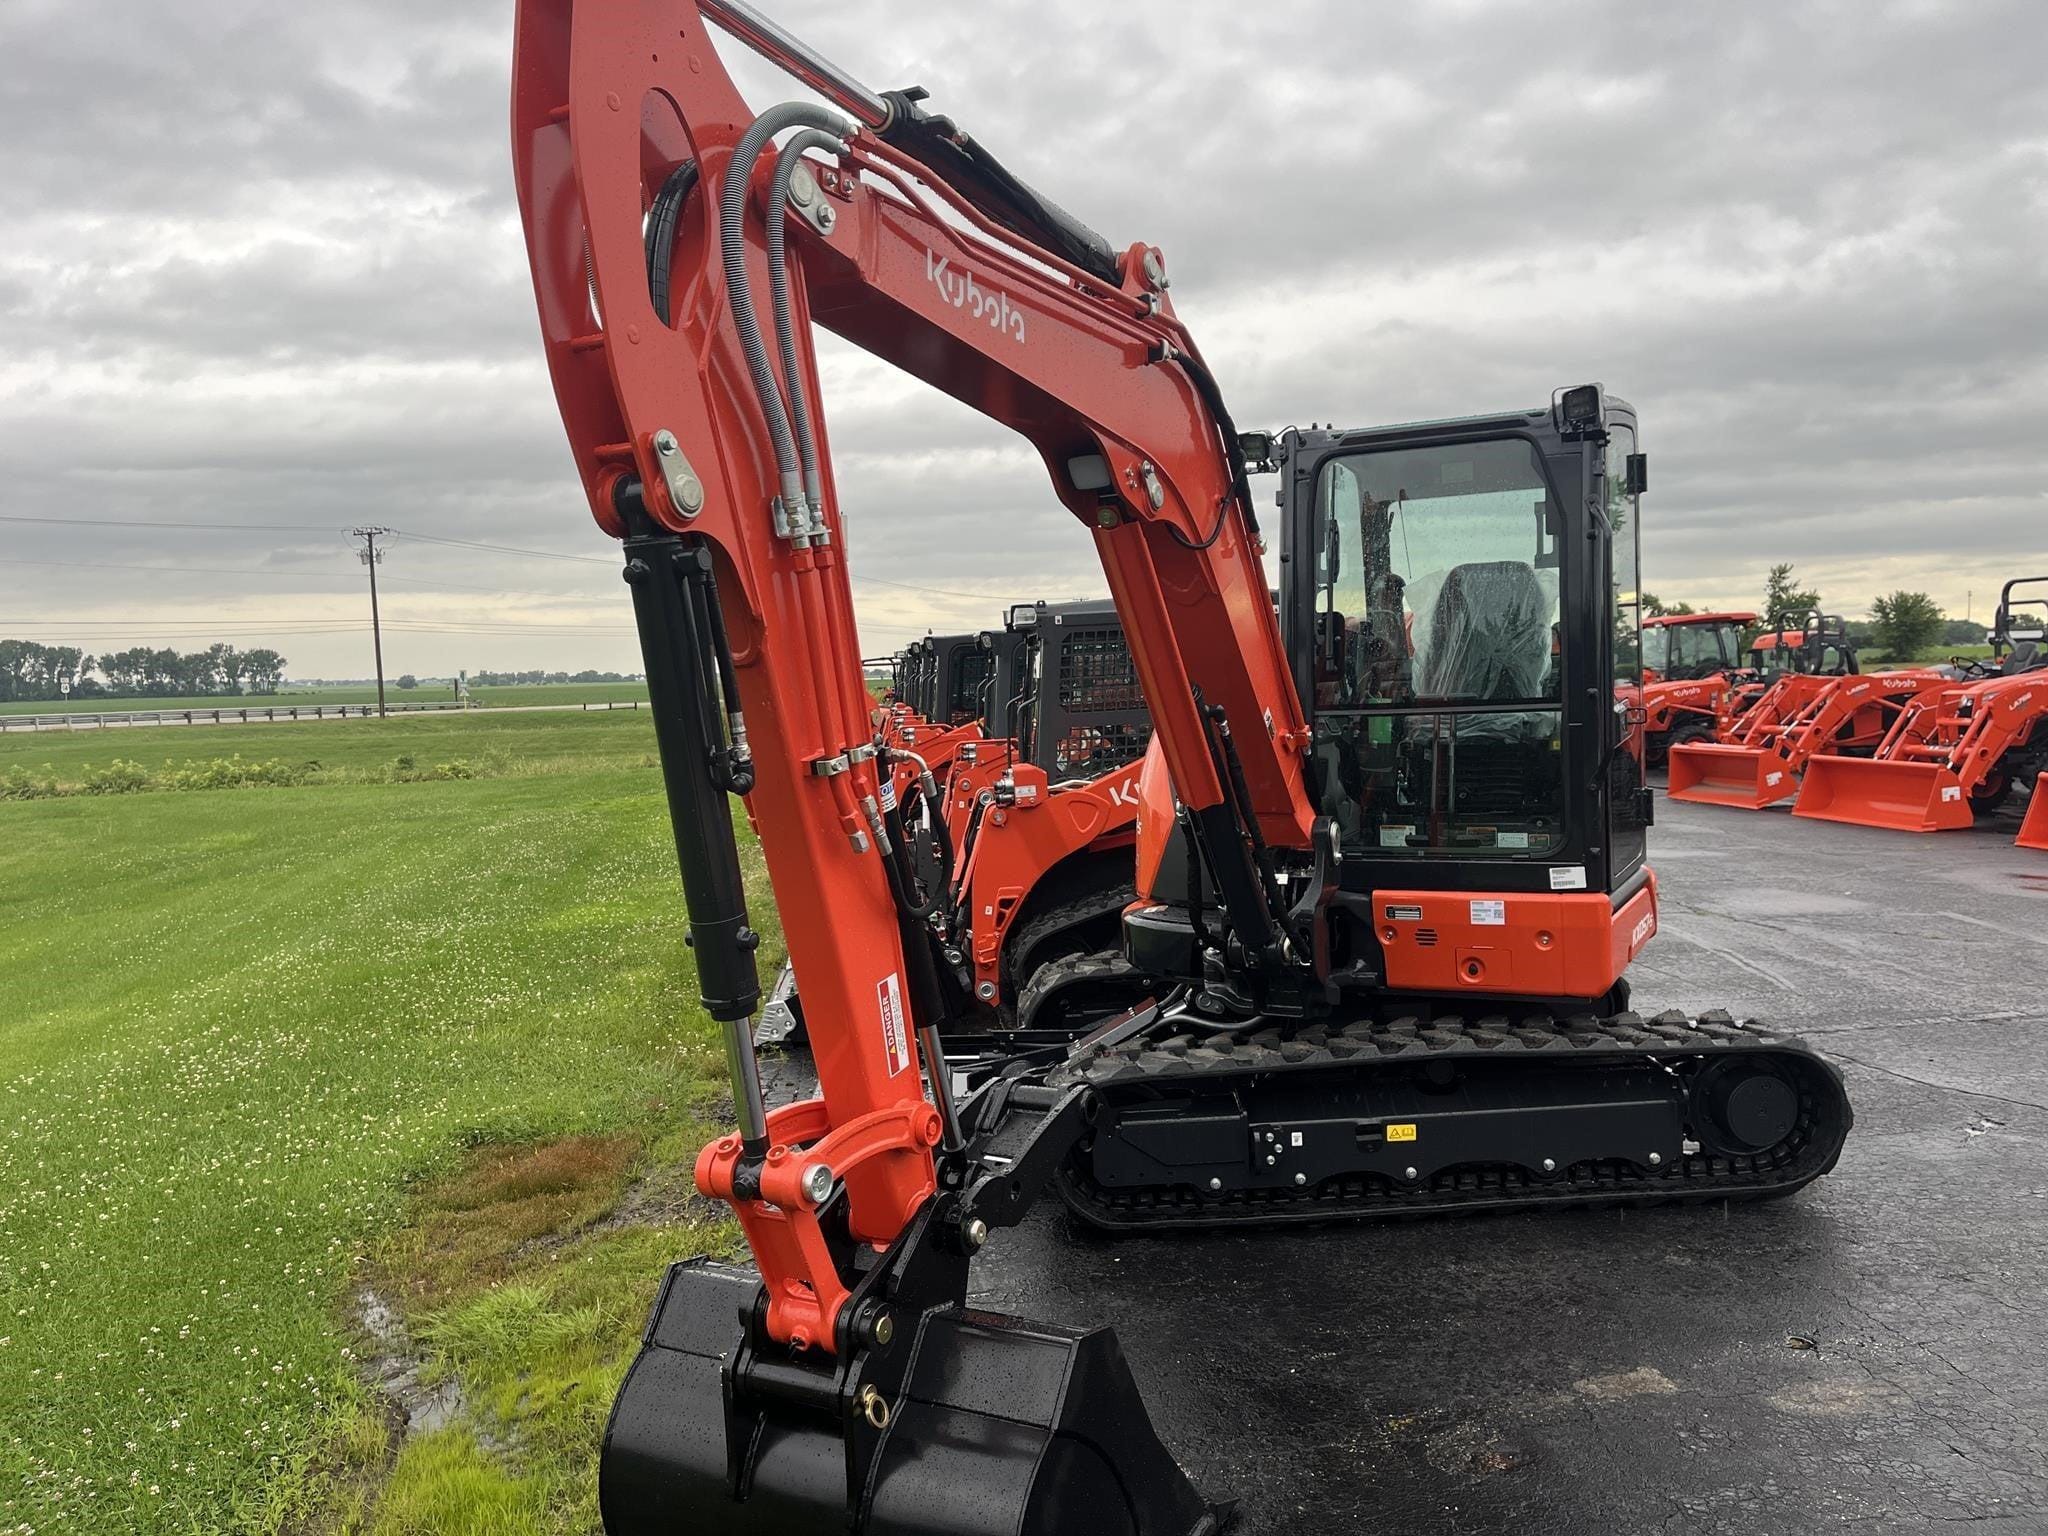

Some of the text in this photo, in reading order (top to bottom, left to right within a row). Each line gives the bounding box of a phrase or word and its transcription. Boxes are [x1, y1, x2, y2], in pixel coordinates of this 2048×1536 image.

[926, 247, 1025, 344] Kubota
[1882, 679, 1917, 688] Kubota
[882, 995, 895, 1046] DANGER
